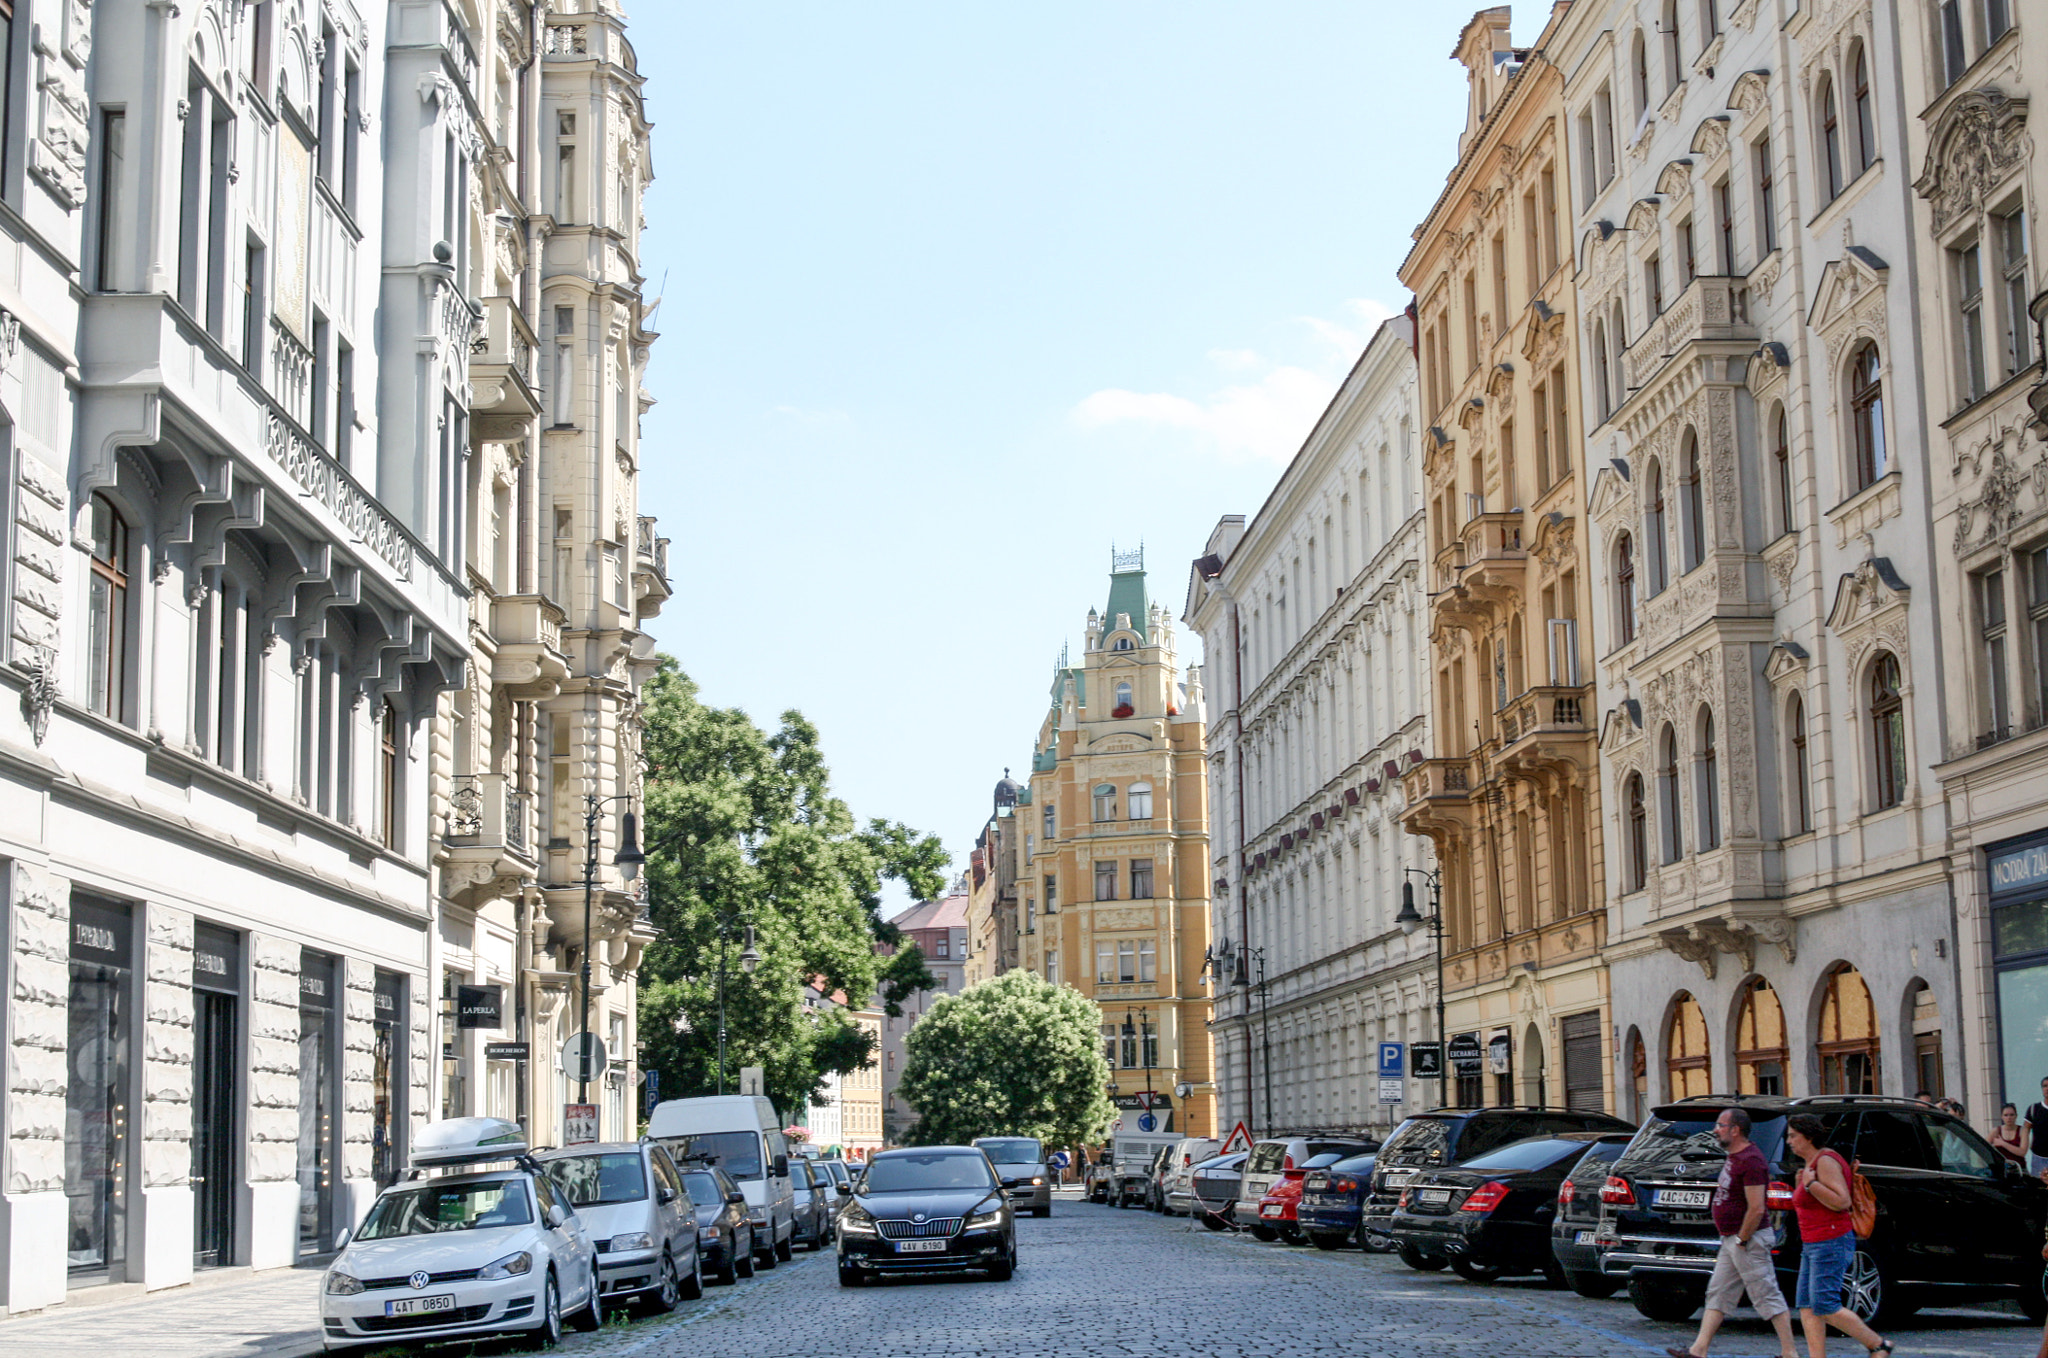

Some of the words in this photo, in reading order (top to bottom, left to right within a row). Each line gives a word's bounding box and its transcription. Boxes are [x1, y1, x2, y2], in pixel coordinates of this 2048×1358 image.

[462, 1006, 473, 1014] LA
[473, 1006, 496, 1014] PERLA
[1383, 1046, 1399, 1067] P
[1450, 1050, 1479, 1058] EXCHANGE
[648, 1092, 657, 1108] P
[1683, 1191, 1706, 1204] 4763
[902, 1242, 917, 1250] 4AV
[922, 1241, 942, 1250] 6190
[395, 1301, 414, 1313] 4AT
[422, 1297, 449, 1311] 0850
